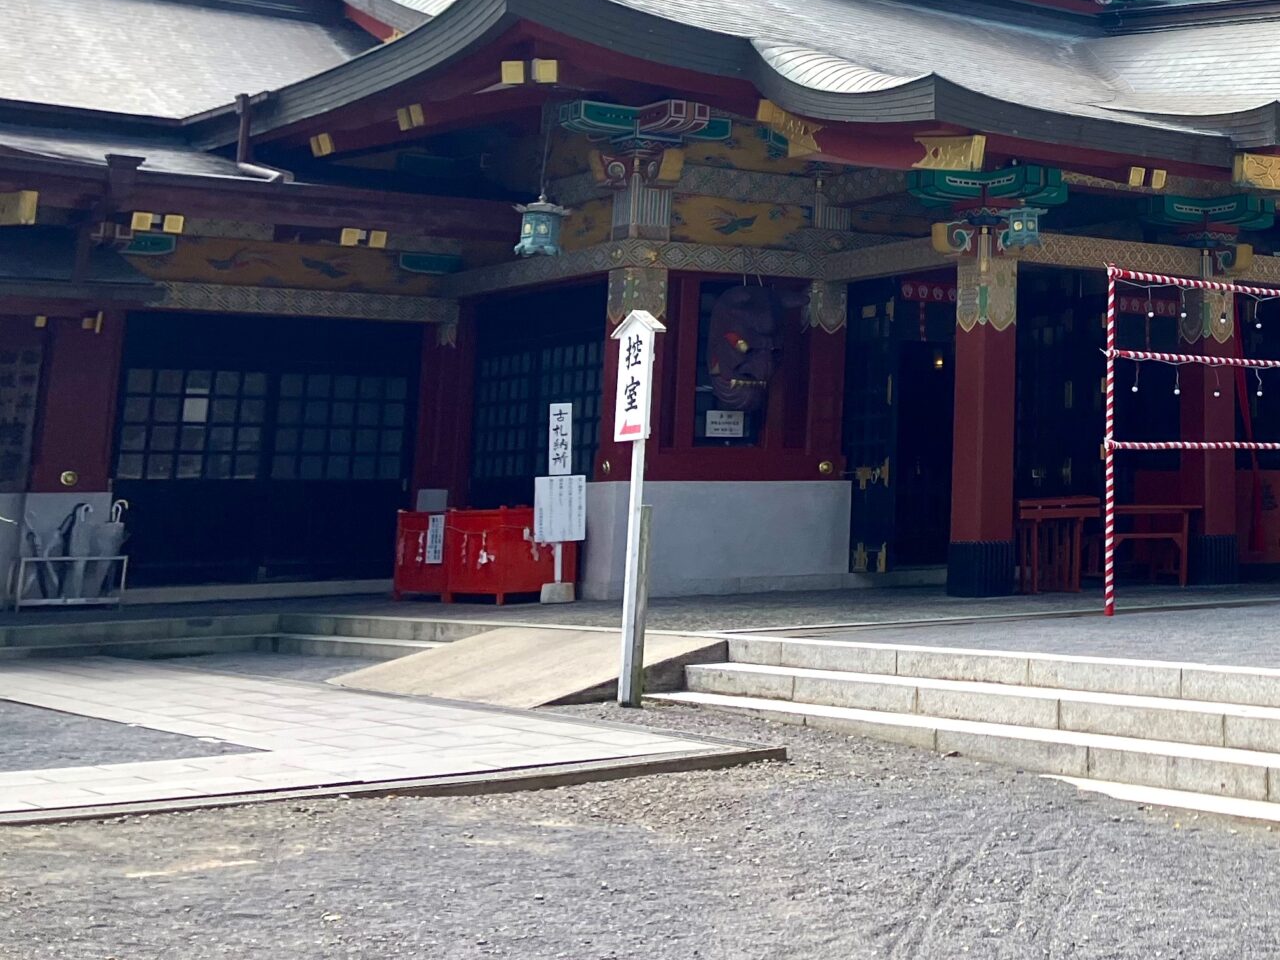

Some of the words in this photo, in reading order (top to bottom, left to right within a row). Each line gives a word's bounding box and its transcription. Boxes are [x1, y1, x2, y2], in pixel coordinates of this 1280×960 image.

[624, 334, 643, 412] 控室
[552, 408, 568, 470] 古札納所
